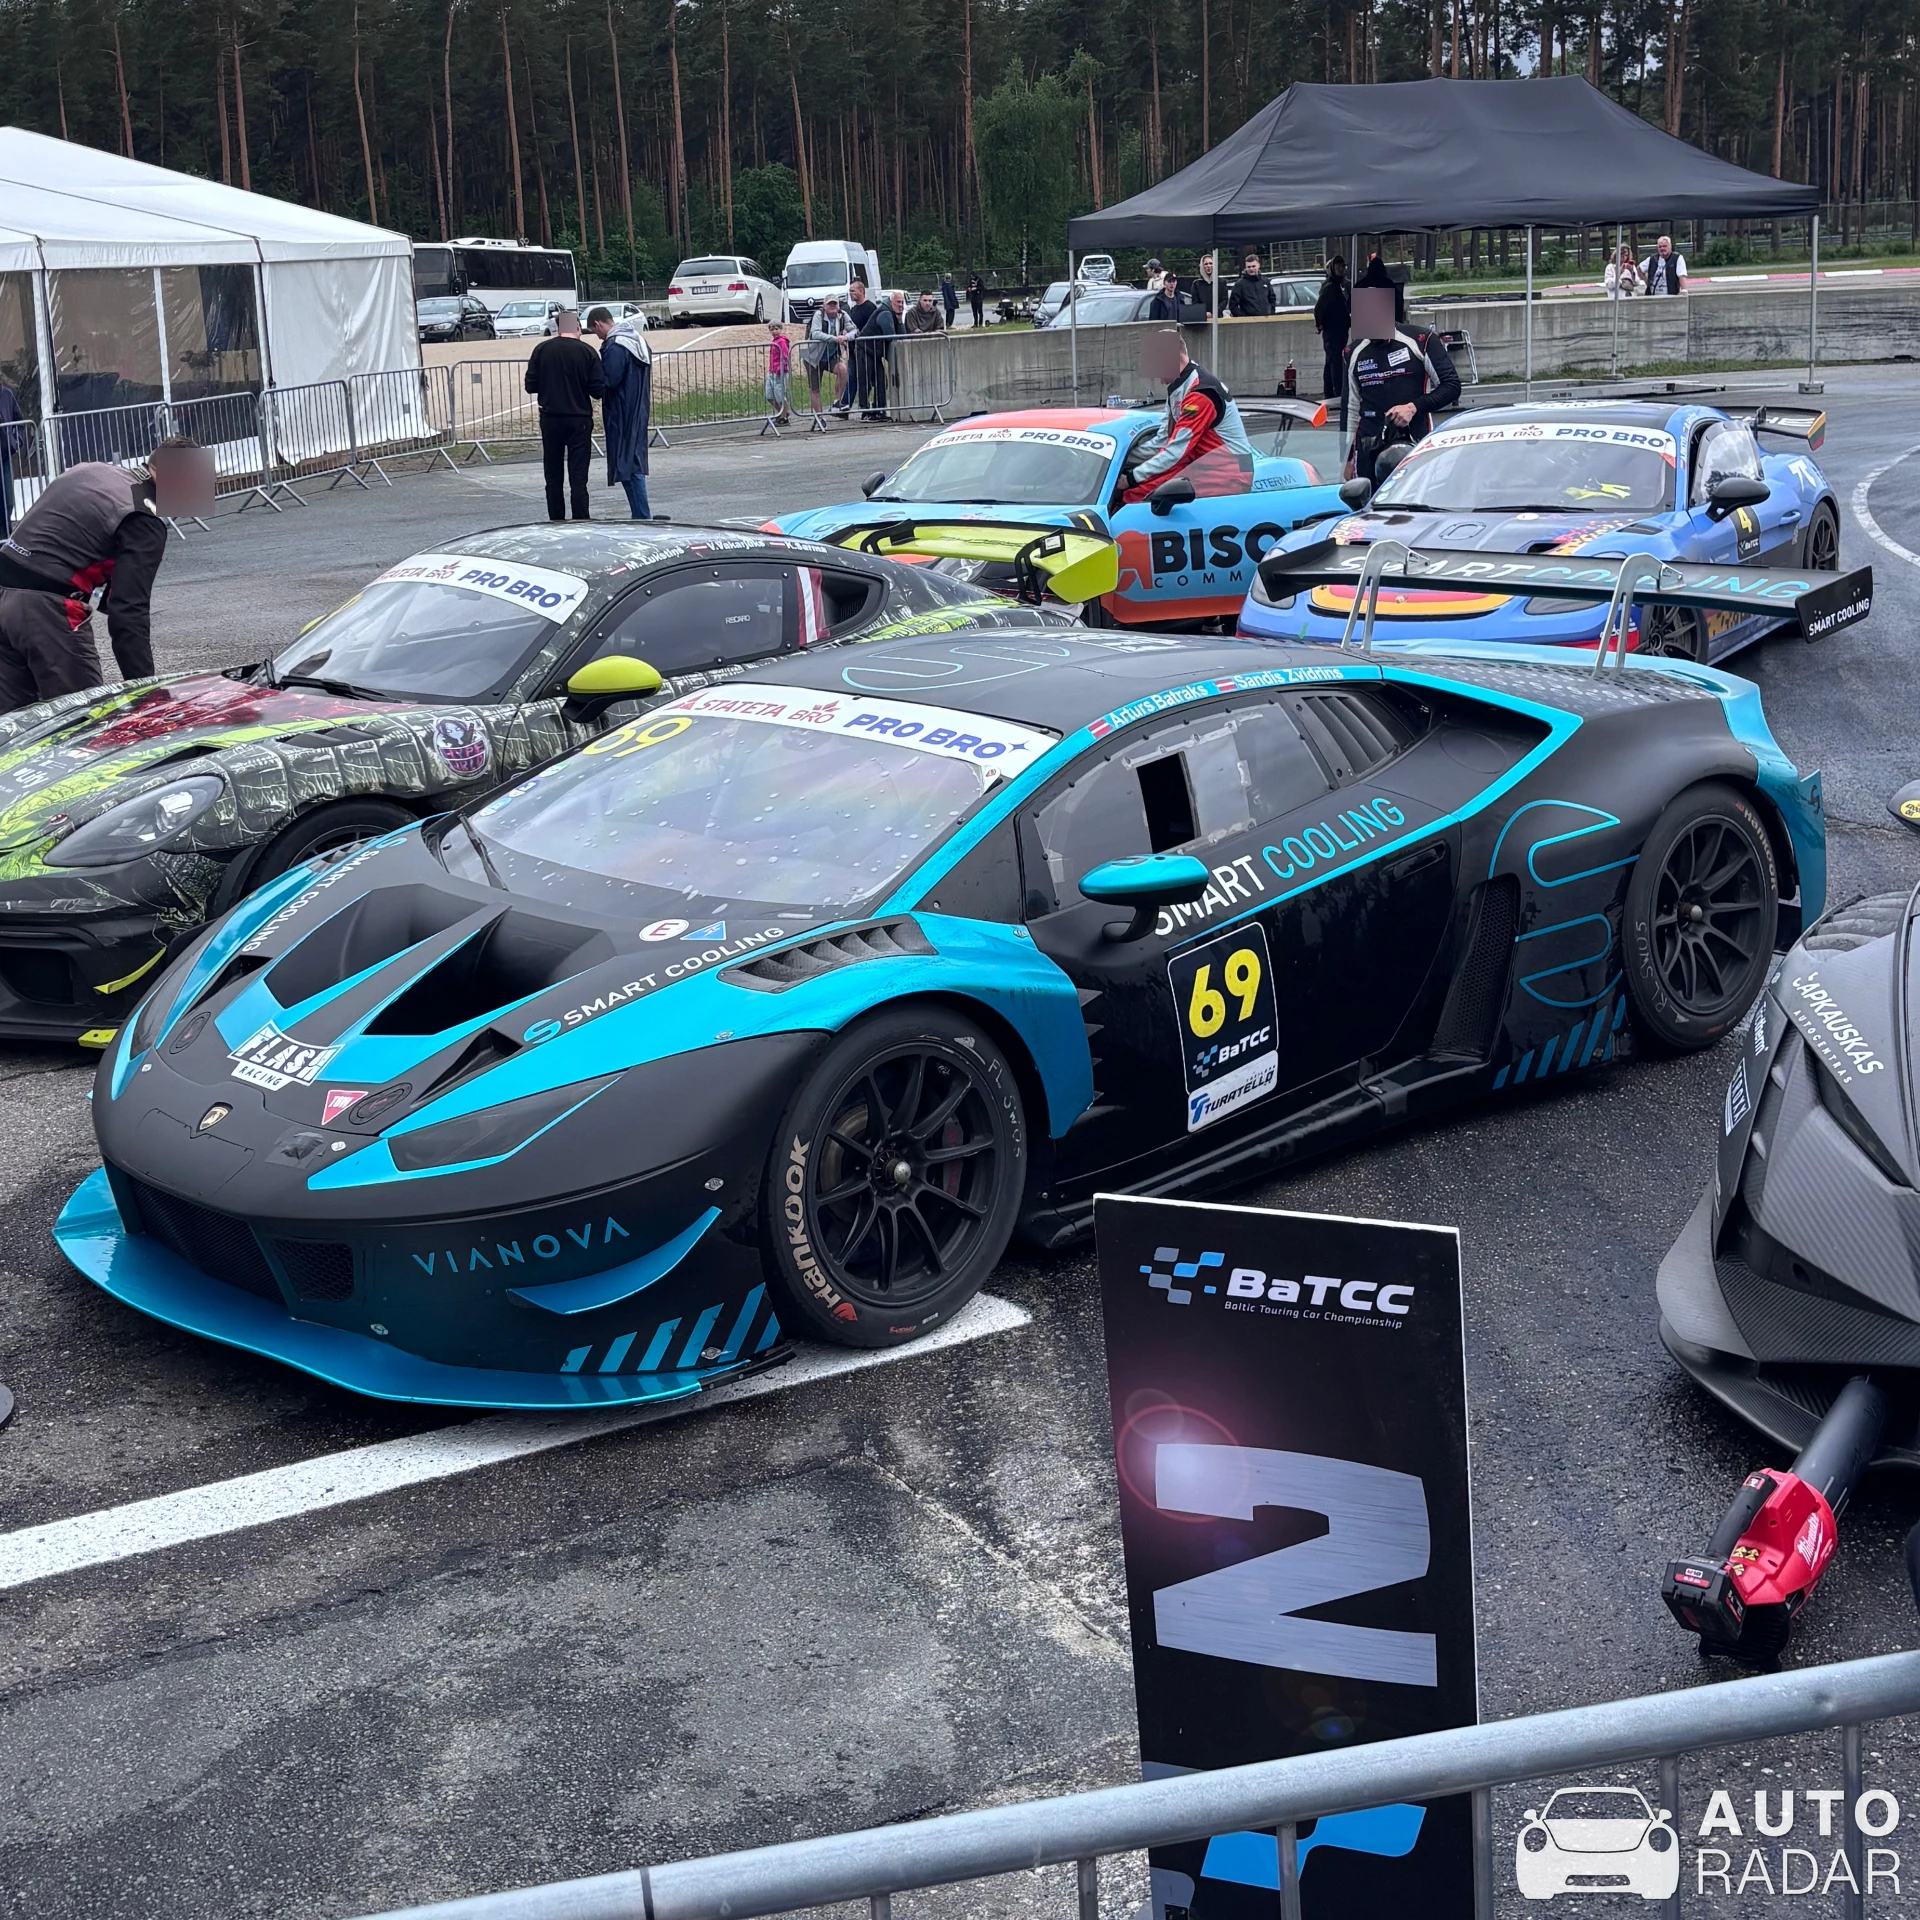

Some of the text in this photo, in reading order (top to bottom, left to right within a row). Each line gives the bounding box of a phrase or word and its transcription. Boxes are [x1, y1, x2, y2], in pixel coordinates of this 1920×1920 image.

[934, 433, 983, 448] STATETA
[1020, 431, 1060, 441] PRO
[1062, 435, 1104, 450] BRO
[1439, 430, 1504, 446] STATETA
[1556, 428, 1607, 439] PRO
[1612, 431, 1664, 448] BRO
[1253, 475, 1297, 491] OTERMA
[1736, 508, 1752, 533] 4
[1151, 520, 1305, 574] BISO
[1325, 556, 1535, 578] SART
[458, 569, 508, 588] PRO
[505, 579, 562, 609] BRO
[1809, 598, 1870, 637] SMART COOLING
[1109, 695, 1156, 728] Arturs
[1152, 684, 1209, 709] Batraks
[1234, 670, 1284, 690] Sandis
[694, 699, 1006, 759] STATETA BRO PRO BRO
[1261, 797, 1405, 879] COOLING
[242, 850, 380, 952] SMART COOLING
[563, 973, 656, 1026] SMART
[665, 927, 785, 978] COOLING
[1189, 948, 1261, 1038] 69
[235, 1026, 336, 1082] FLASH
[1218, 1025, 1271, 1064] BaTCC
[1793, 1010, 1853, 1084] AUTOCENTRAS
[238, 1066, 283, 1086] RACING
[328, 1095, 353, 1108] TOW
[412, 1216, 630, 1276] VIANOVA
[1226, 1267, 1415, 1314] BaTCC
[1224, 1301, 1403, 1330] Baltic Touring Car Championship
